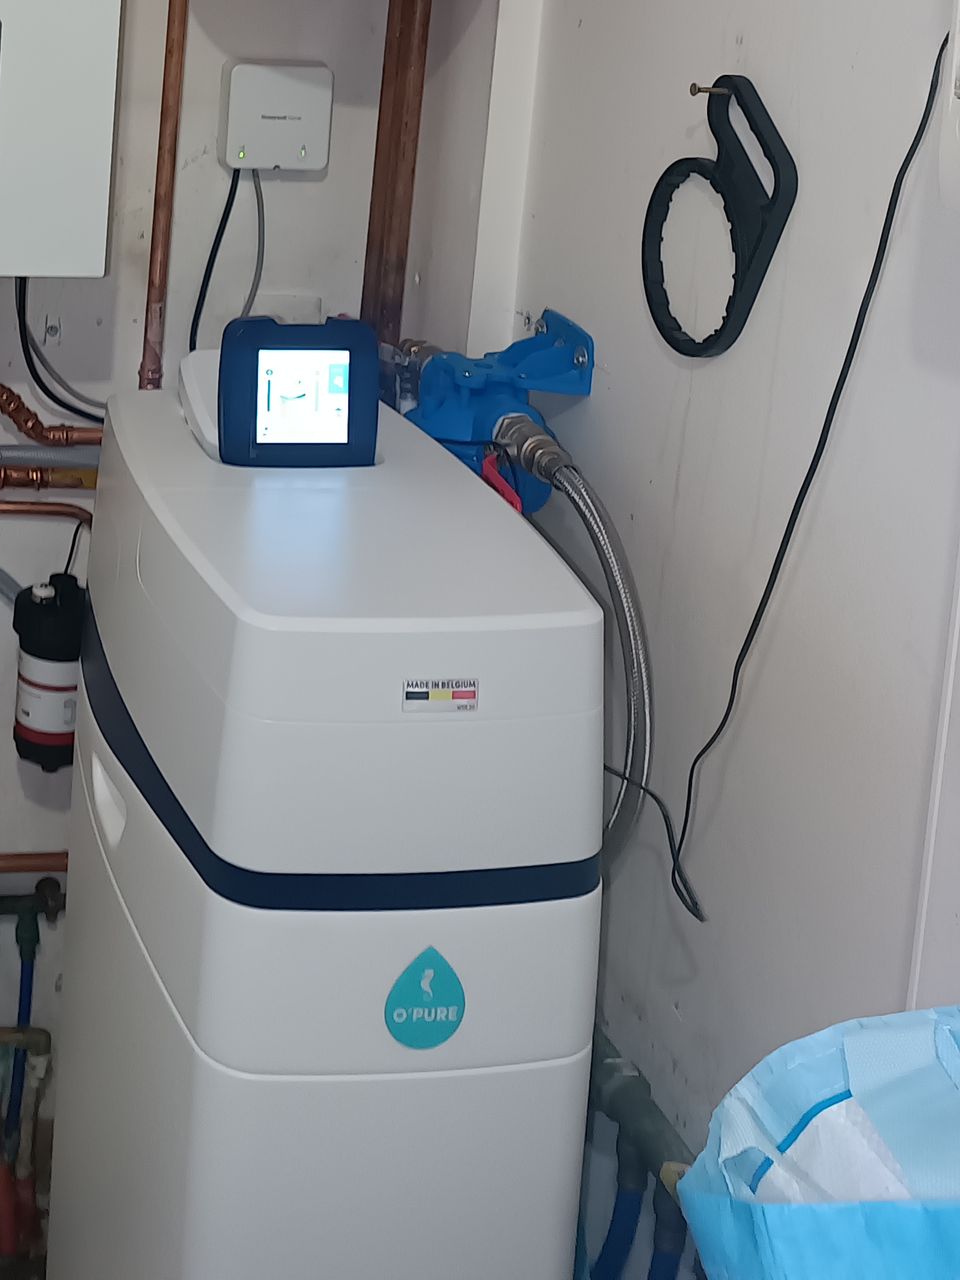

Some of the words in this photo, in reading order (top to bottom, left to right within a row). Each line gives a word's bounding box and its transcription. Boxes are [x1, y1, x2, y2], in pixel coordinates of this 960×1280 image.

[406, 680, 430, 689] MADE
[431, 680, 440, 689] IN
[441, 680, 476, 689] BELGIUM
